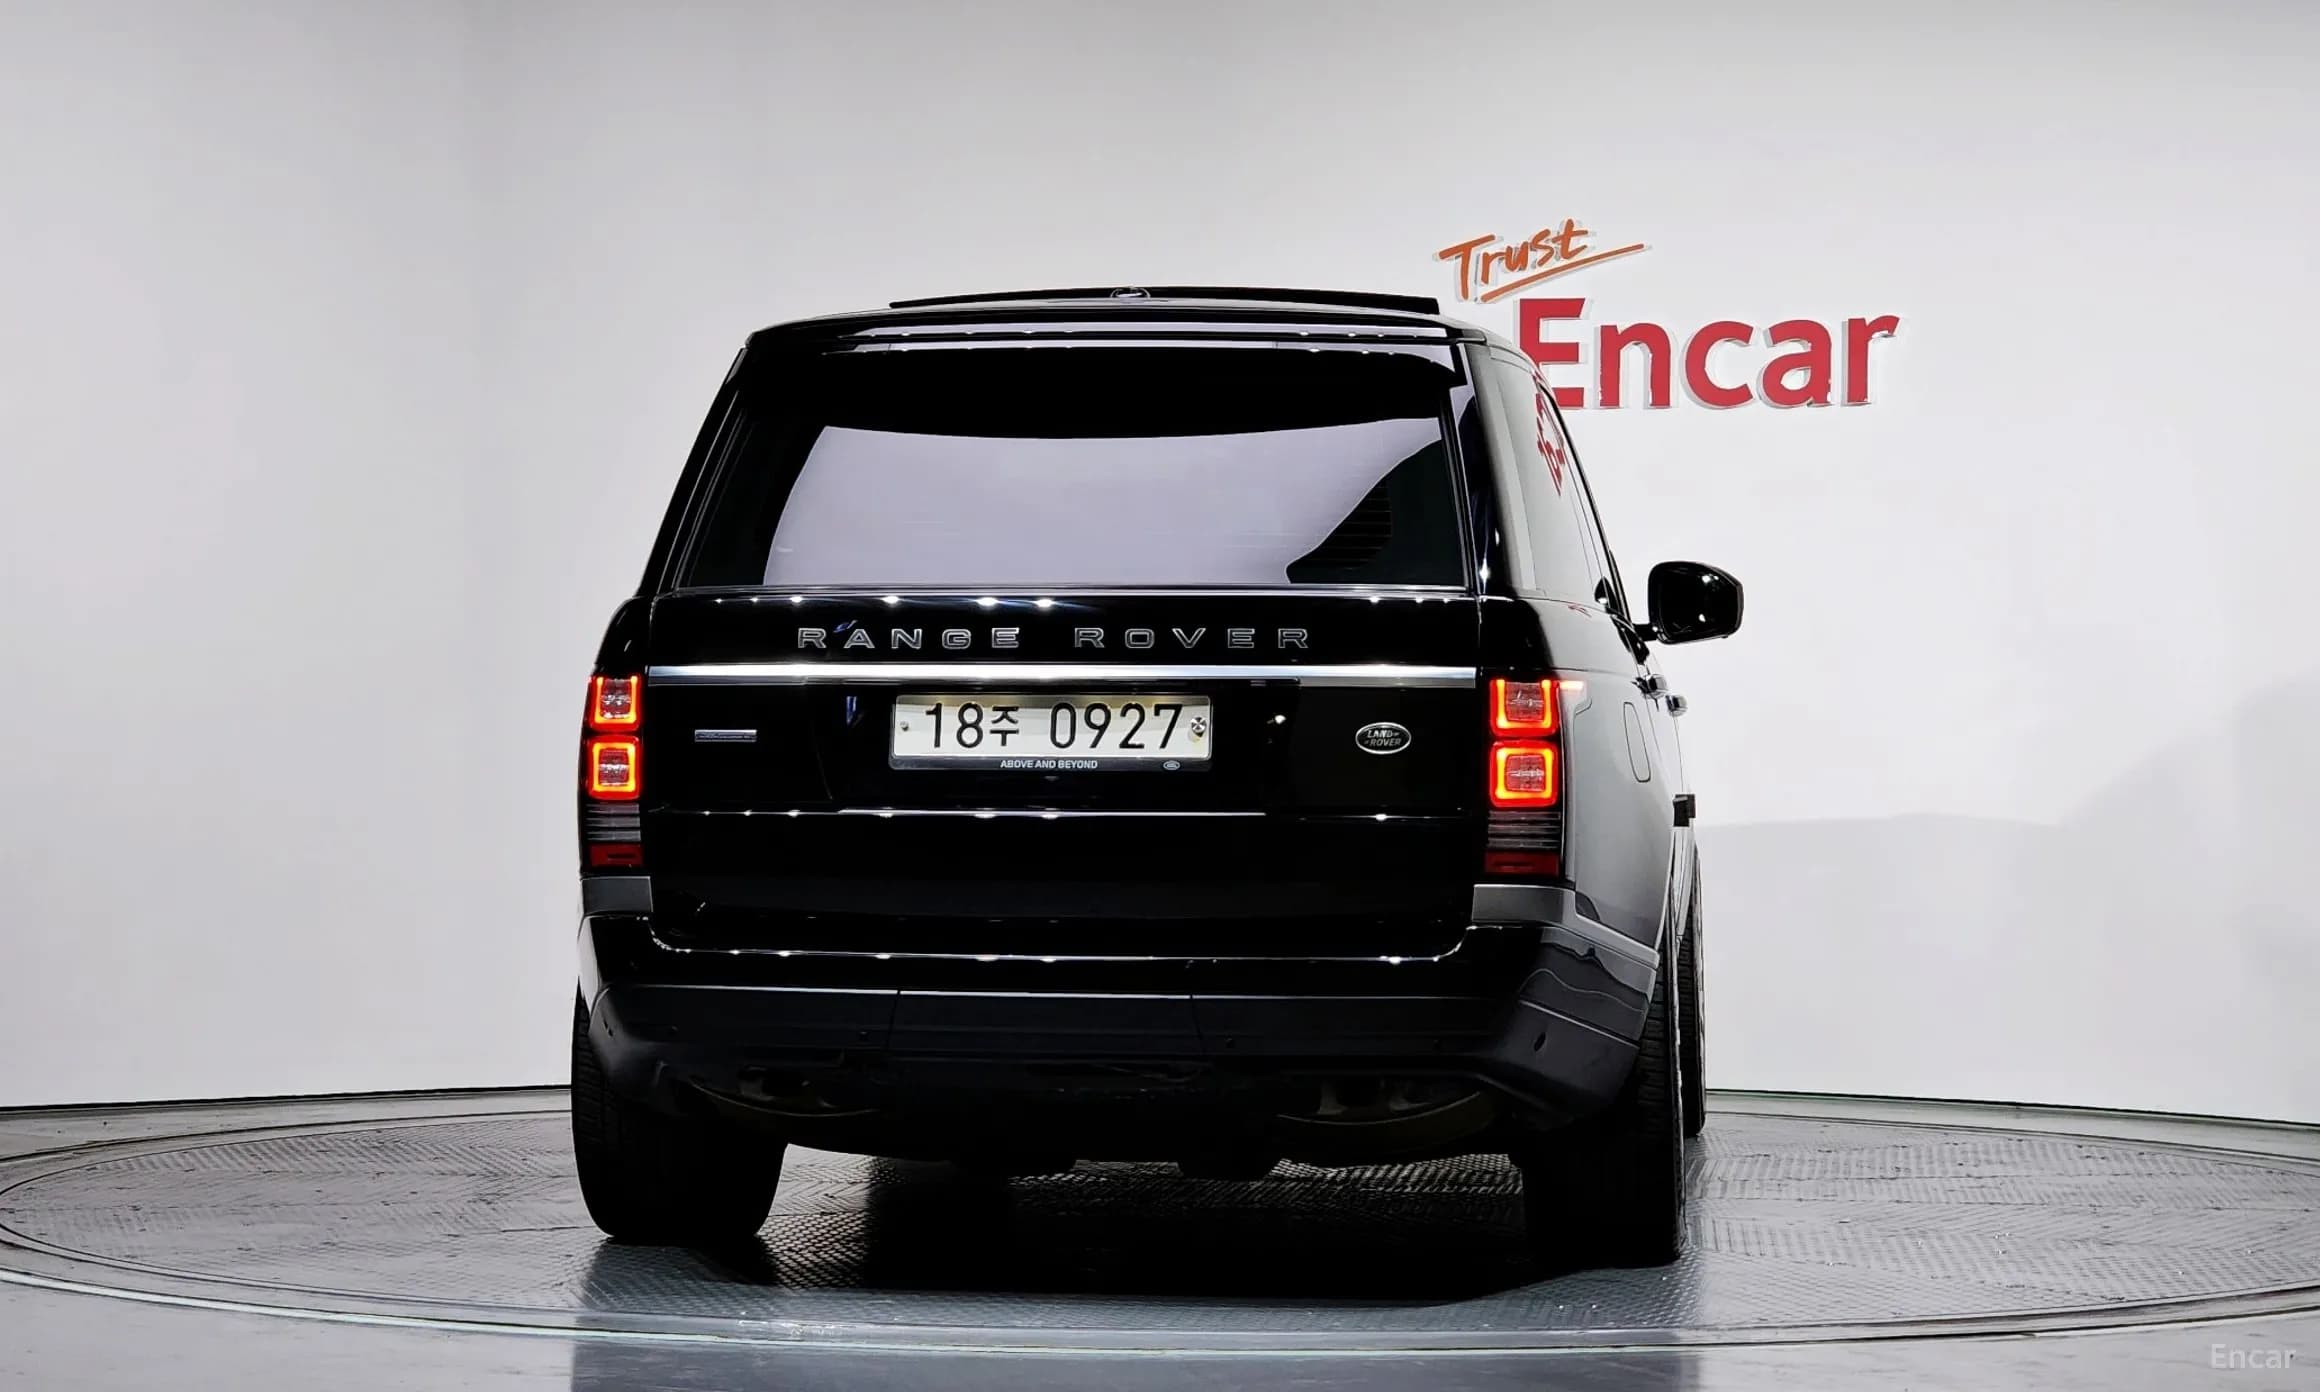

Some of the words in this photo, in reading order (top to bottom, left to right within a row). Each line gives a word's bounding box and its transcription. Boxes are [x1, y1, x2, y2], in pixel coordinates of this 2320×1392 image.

[1438, 218, 1589, 300] Trust
[1518, 297, 1901, 410] Encar
[797, 626, 1020, 650] RANGE
[1074, 627, 1309, 650] ROVER
[925, 701, 1020, 749] 18주
[1050, 702, 1183, 749] 0927
[1000, 760, 1034, 769] ABOVE
[1034, 760, 1056, 769] AND
[1057, 760, 1098, 769] BEYOND
